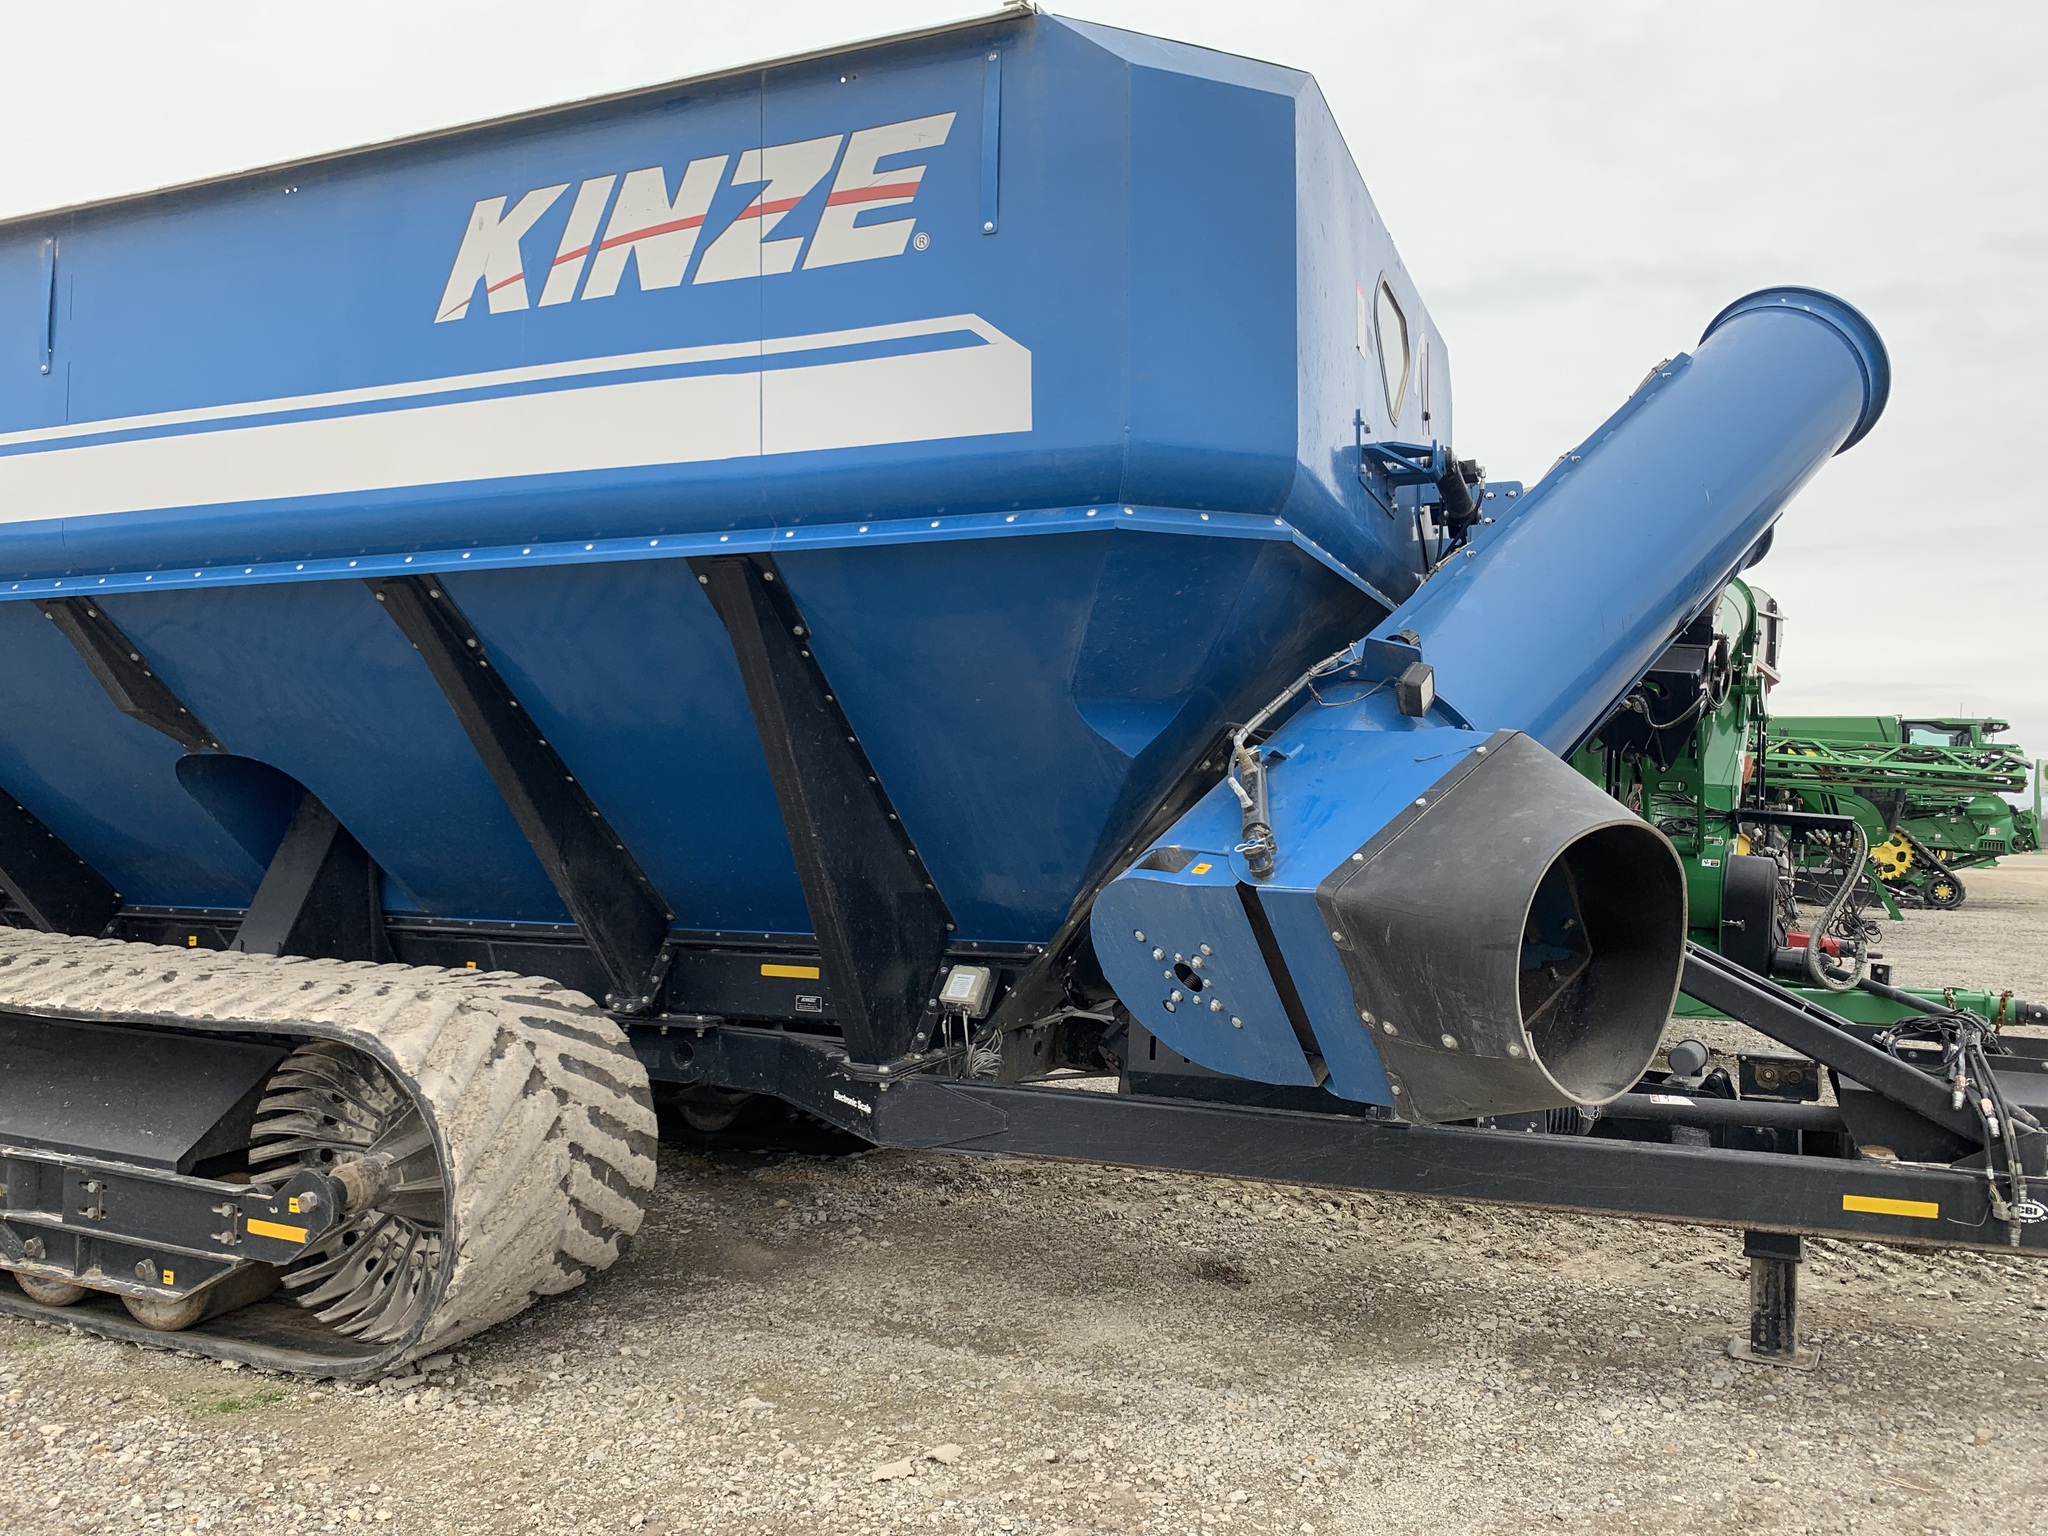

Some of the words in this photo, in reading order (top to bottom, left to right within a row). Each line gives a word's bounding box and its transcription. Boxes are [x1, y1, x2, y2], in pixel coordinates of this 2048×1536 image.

[434, 112, 957, 323] KINZE
[833, 1089, 857, 1107] Electronic
[857, 1100, 872, 1114] Scale
